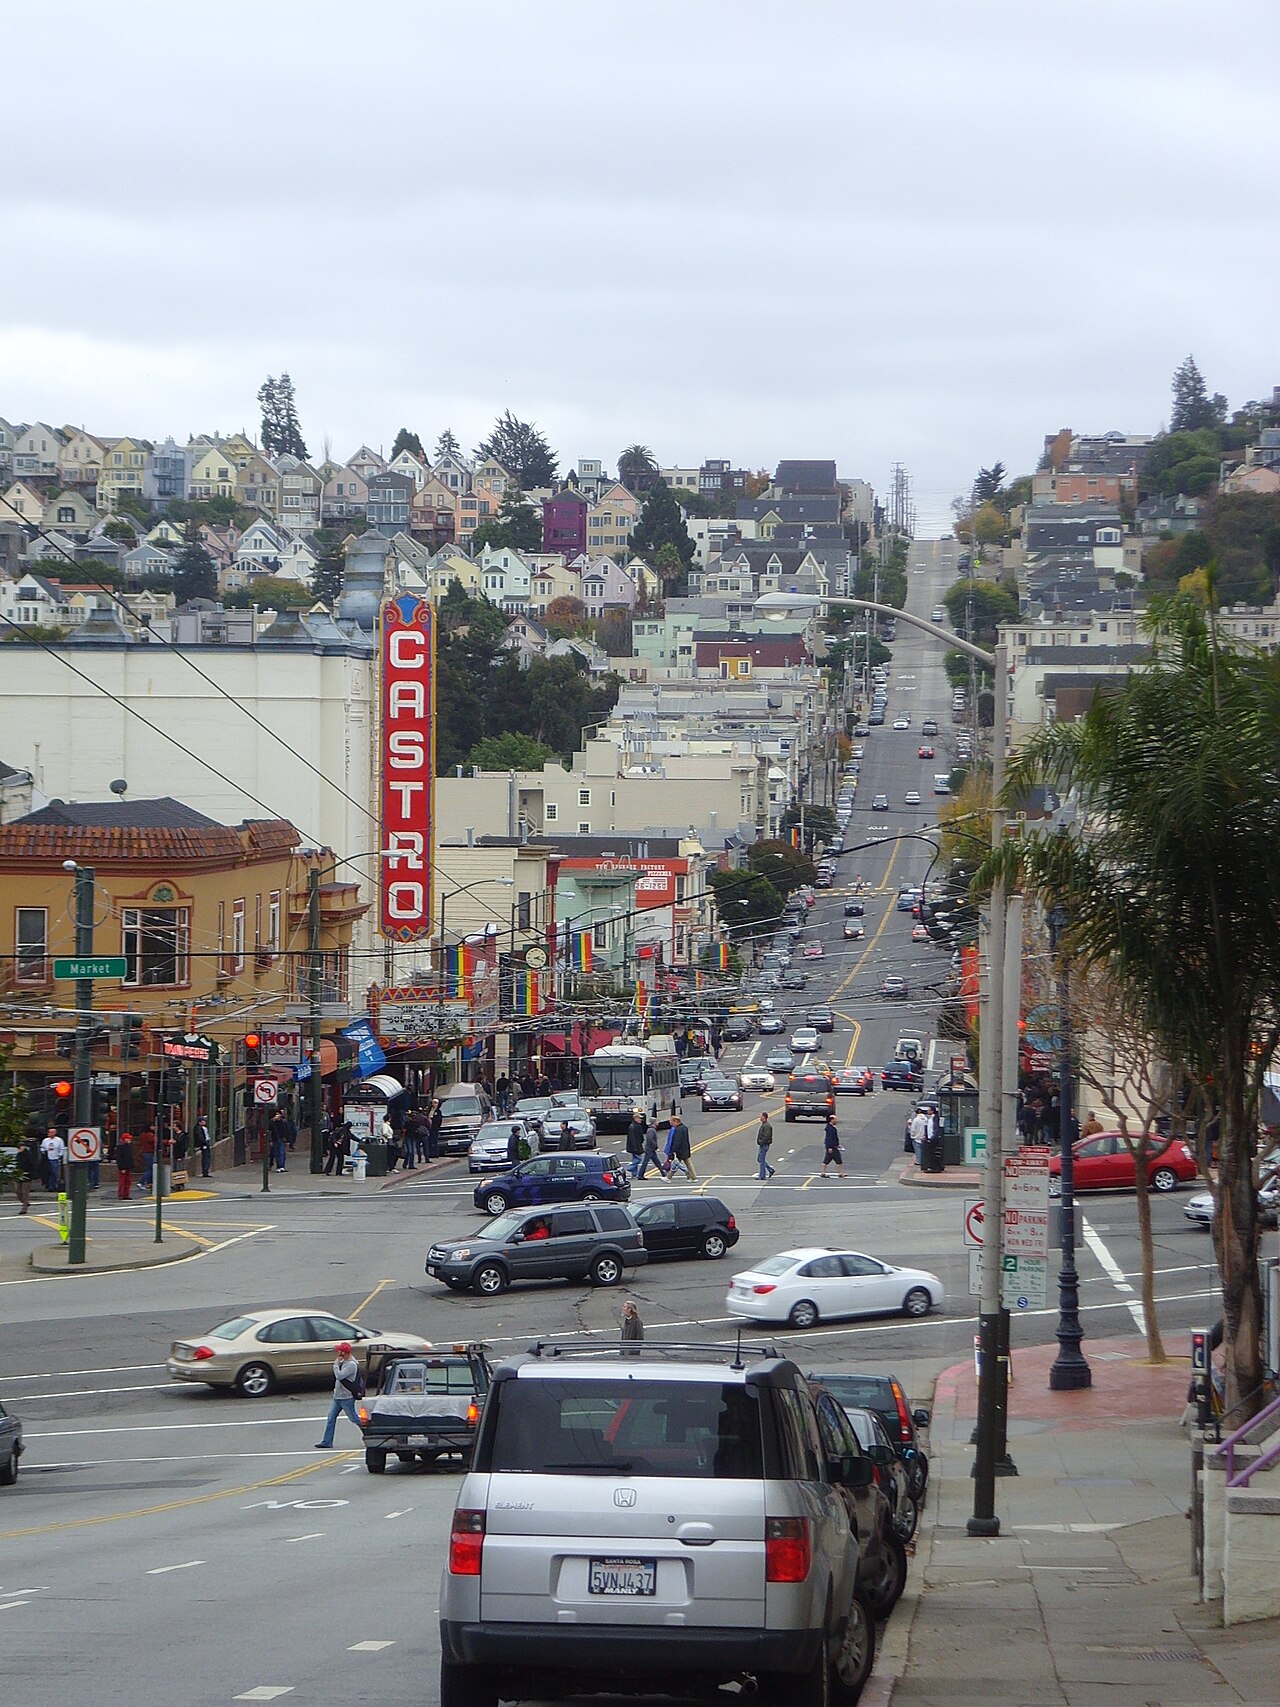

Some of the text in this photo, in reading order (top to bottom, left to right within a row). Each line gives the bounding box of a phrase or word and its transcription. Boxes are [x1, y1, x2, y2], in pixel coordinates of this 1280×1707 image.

[389, 630, 425, 919] CASTRO
[70, 963, 110, 974] Market
[262, 1032, 300, 1046] HOT
[263, 1047, 299, 1056] COOKIE
[1005, 1167, 1018, 1176] NO
[1006, 1212, 1048, 1225] NO PARKING
[1006, 1258, 1015, 1269] 2
[495, 1502, 535, 1510] ELEMENT
[594, 1571, 652, 1590] 5VNJ437
